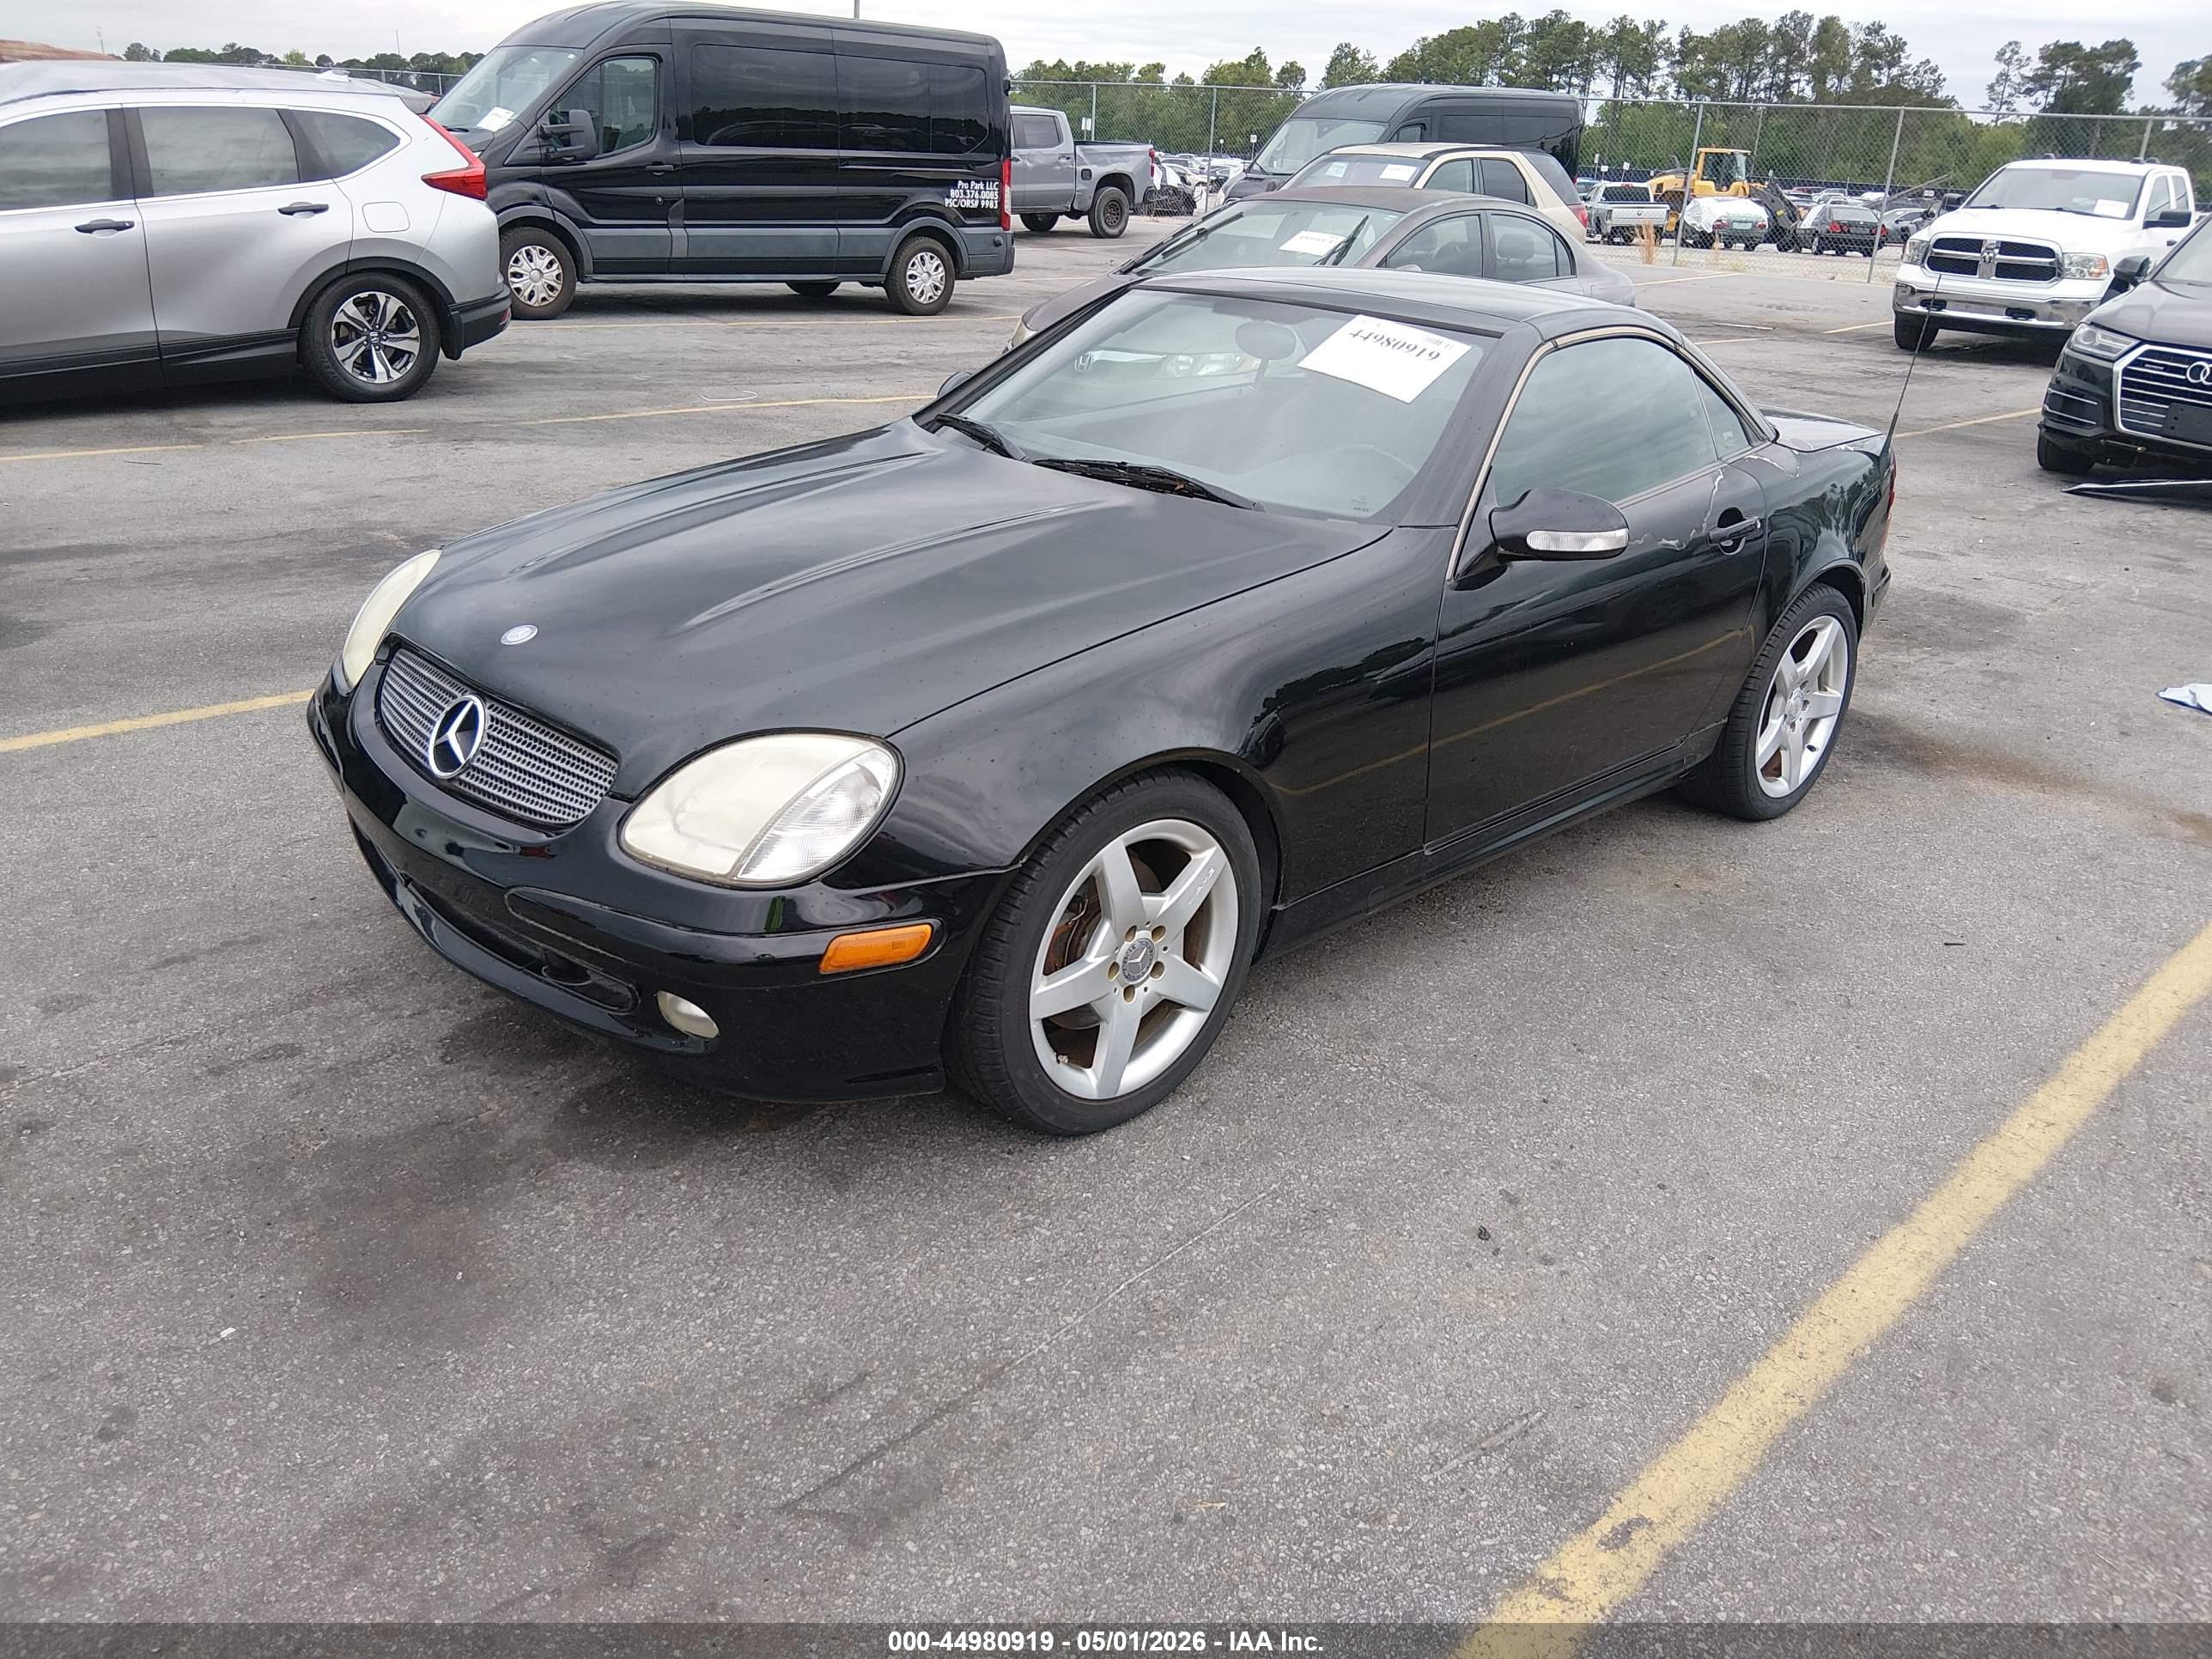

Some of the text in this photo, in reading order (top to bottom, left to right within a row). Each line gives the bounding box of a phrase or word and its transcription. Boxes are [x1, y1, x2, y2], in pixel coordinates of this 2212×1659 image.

[957, 180, 999, 190] Pro Park LLC
[950, 189, 999, 199] 803.376.0085
[981, 199, 999, 209] 9983
[1349, 329, 1440, 361] 44980919
